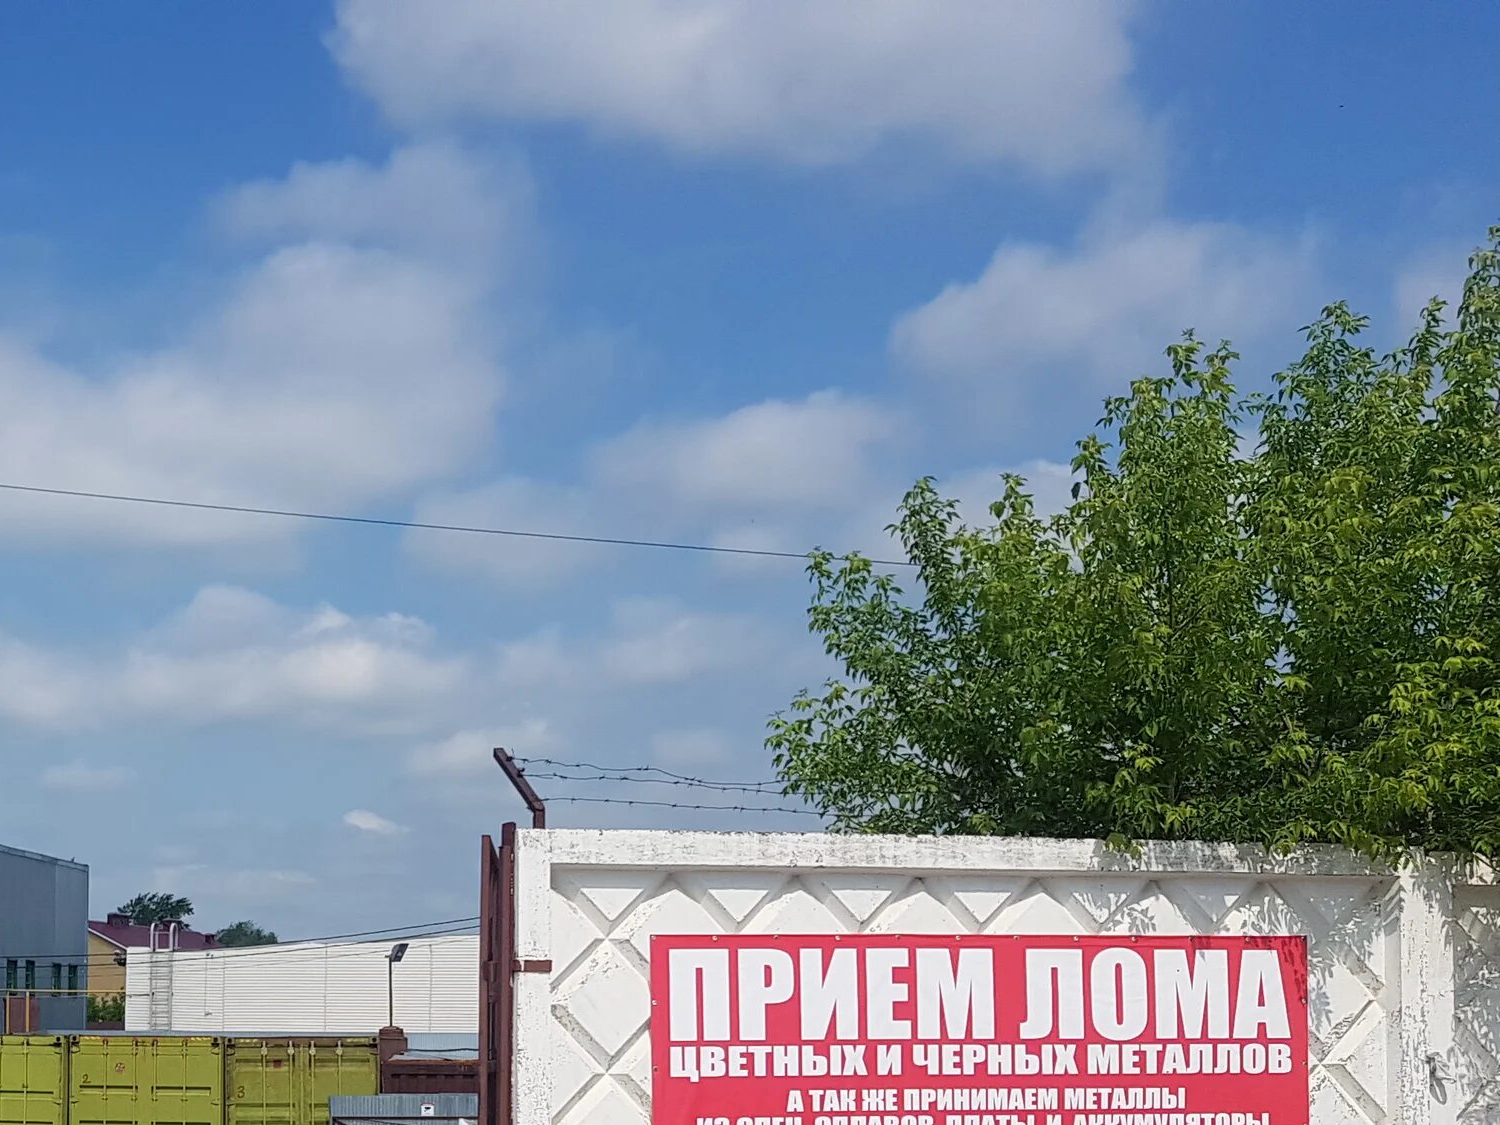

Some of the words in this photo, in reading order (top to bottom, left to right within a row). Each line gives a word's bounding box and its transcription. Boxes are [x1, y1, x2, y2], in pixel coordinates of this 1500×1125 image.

[667, 947, 996, 1042] ПРИЕМ
[1018, 947, 1292, 1041] ЛОМА
[669, 1044, 869, 1083] ЦВЕТНЫХ
[876, 1044, 903, 1076] И
[911, 1043, 1080, 1076] ЧЕРНЫХ
[1086, 1042, 1293, 1075] МЕТАЛЛОВ
[82, 1073, 92, 1084] 2
[236, 1086, 245, 1099] 3
[786, 1089, 803, 1113] А
[808, 1089, 857, 1112] ТАК
[861, 1088, 898, 1112] ЖЕ
[903, 1087, 1059, 1111] ПРИНИМАЕМ
[1063, 1086, 1186, 1110] МЕТАЛЛЫ
